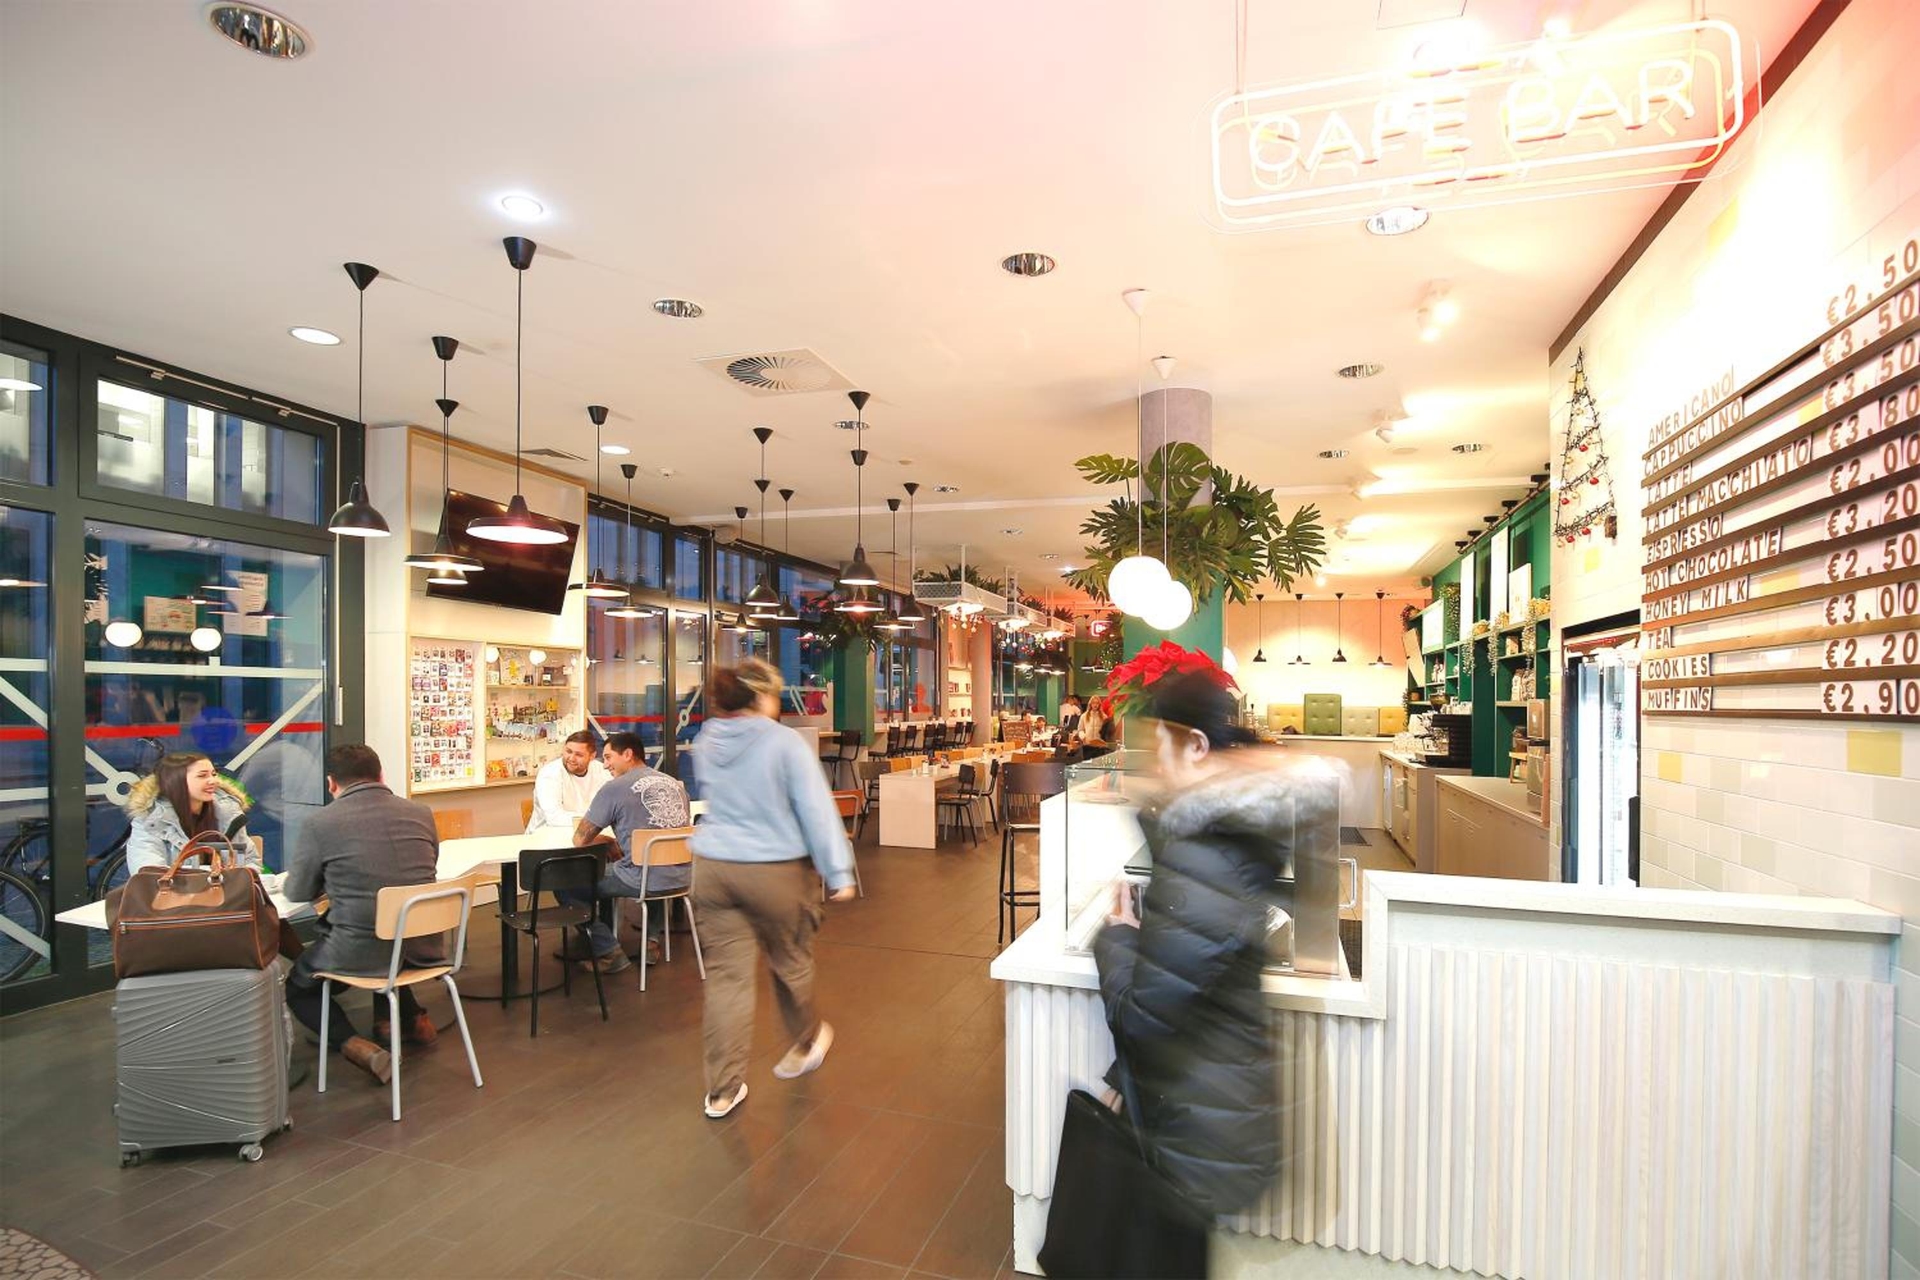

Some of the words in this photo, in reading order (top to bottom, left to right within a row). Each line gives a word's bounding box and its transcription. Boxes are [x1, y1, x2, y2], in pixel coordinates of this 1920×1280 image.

[1503, 60, 1696, 142] BAR
[1644, 399, 1742, 476] CAPPUCCINO
[1822, 289, 1916, 369] €3.50
[1648, 370, 1732, 447] AMERICANO
[1826, 239, 1919, 326] €2.50
[1646, 496, 1686, 534] LATTE
[1697, 438, 1809, 509] MACCHIATO
[1828, 384, 1919, 452] €3.80
[1647, 464, 1690, 504] LATTE
[1824, 338, 1917, 410] €3.50
[1646, 566, 1669, 592] HOT
[1678, 530, 1779, 581] CHOCOLATE
[1827, 484, 1918, 538] €3.20
[1647, 515, 1722, 563] ESPRESSO
[1829, 433, 1919, 495] €2.00
[1646, 594, 1687, 621] HONEY
[1701, 579, 1746, 608] MILK
[1827, 533, 1917, 583] €2.50
[1648, 629, 1670, 650] TEA
[1825, 582, 1918, 626] €3.00
[1647, 688, 1710, 710] MUFFINS
[1823, 681, 1919, 714] €2.90
[1648, 655, 1708, 679] COOKIES
[1825, 631, 1918, 669] €2.20
